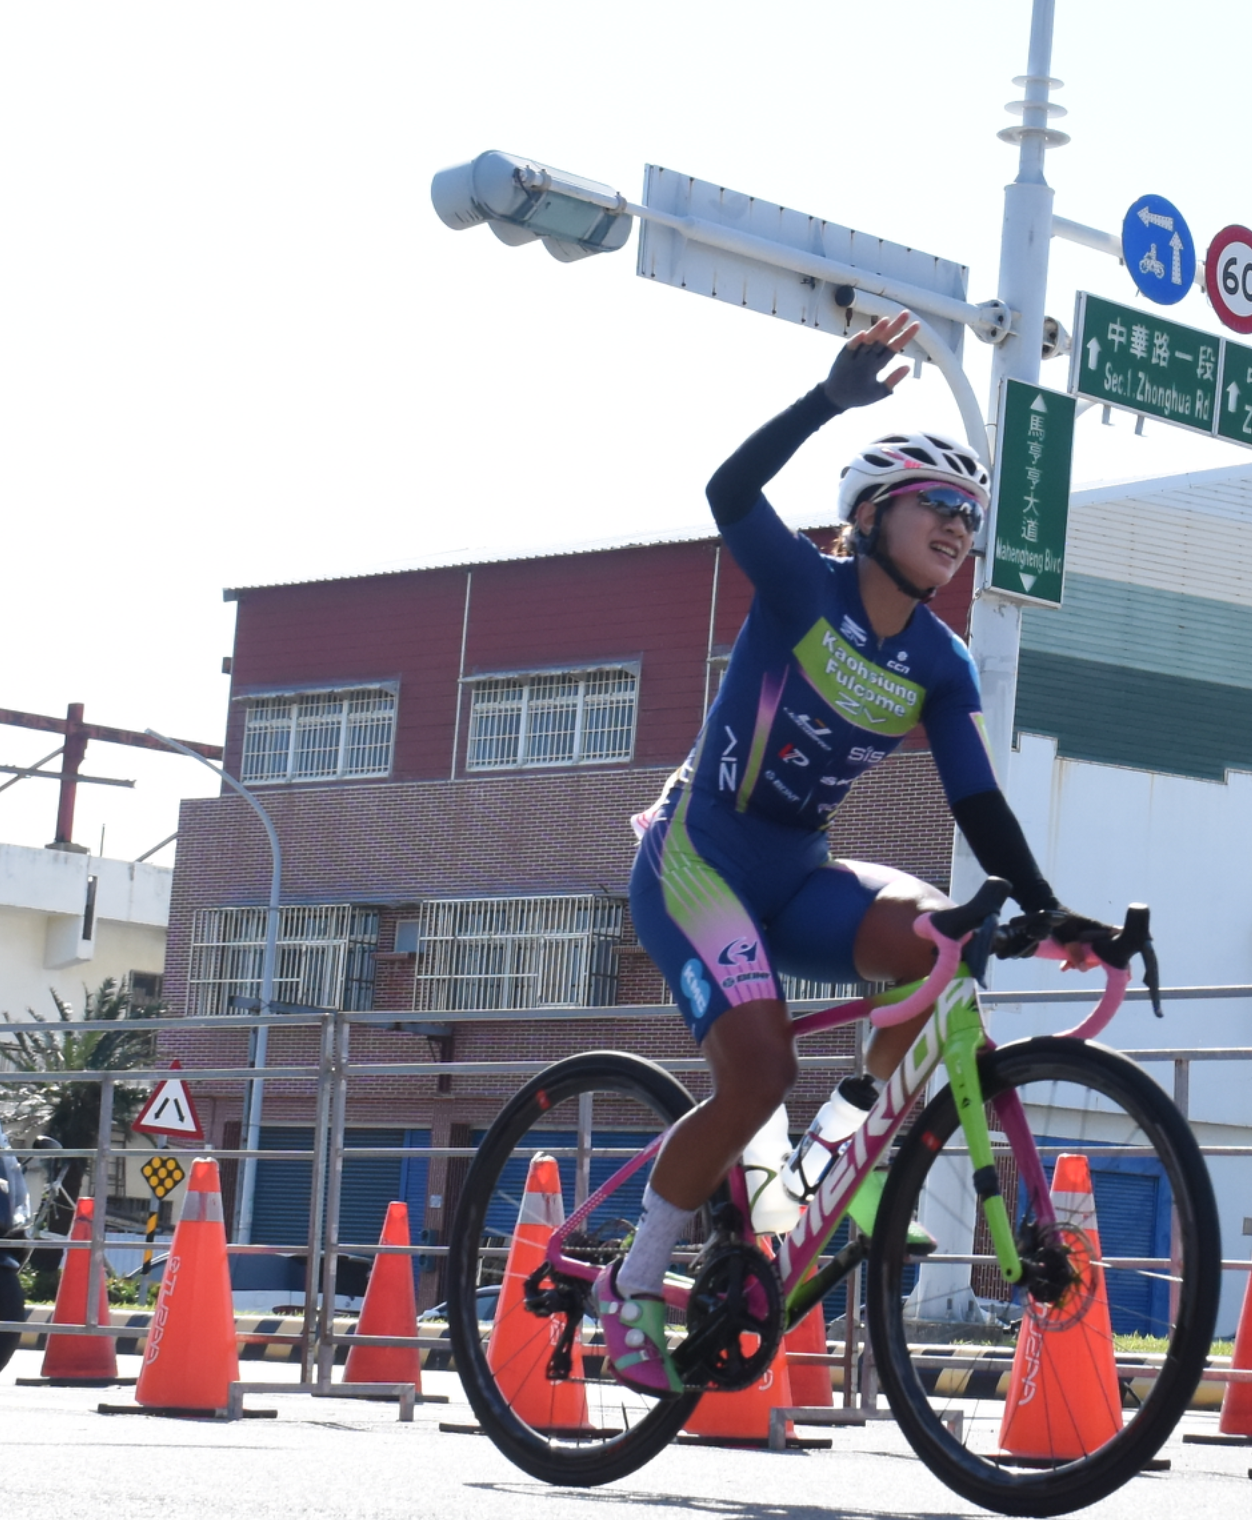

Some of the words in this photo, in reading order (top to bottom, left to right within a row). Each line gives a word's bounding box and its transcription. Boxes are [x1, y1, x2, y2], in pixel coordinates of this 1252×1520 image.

[1107, 317, 1216, 382] 中華路一段
[822, 630, 918, 706] Kaohsiung
[825, 658, 906, 717] Fulcome
